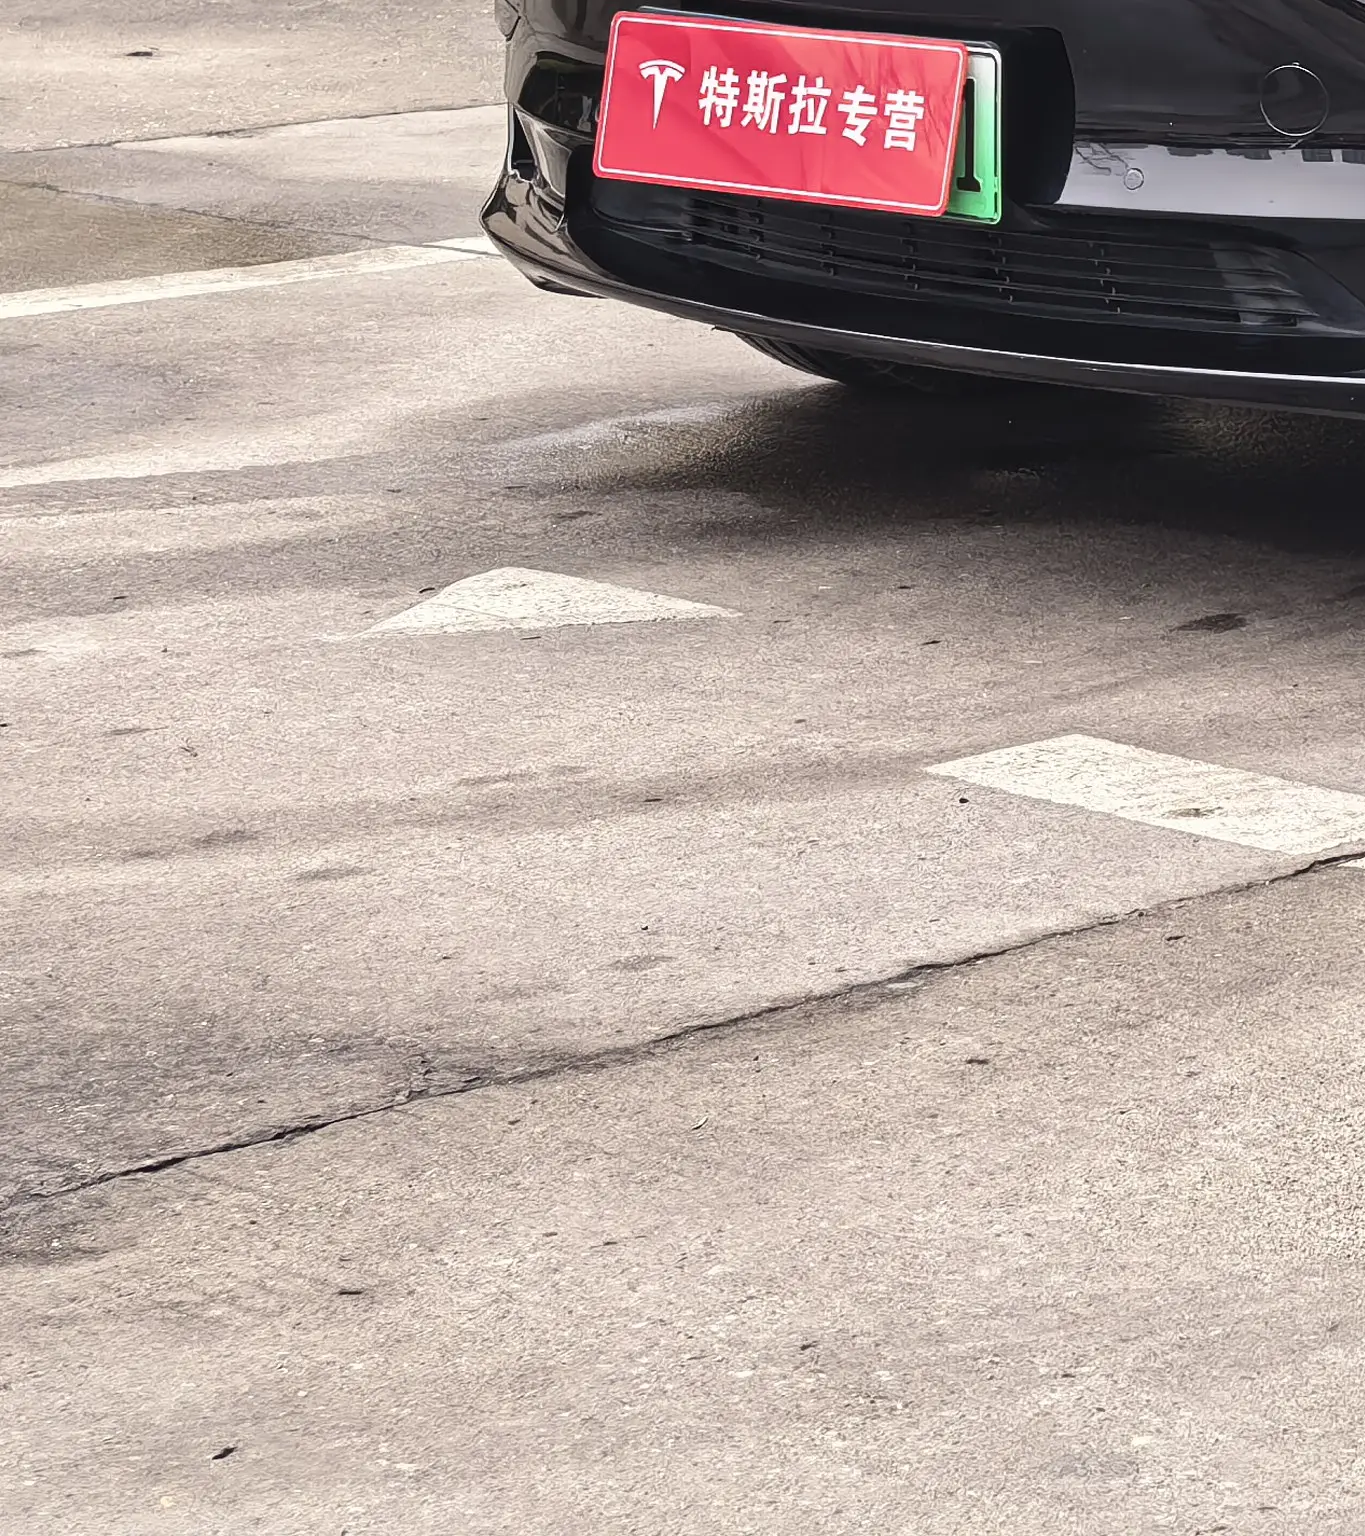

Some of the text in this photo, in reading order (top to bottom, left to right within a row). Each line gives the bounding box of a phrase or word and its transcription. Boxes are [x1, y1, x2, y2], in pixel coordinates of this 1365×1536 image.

[698, 65, 925, 152] 特斯拉专营
